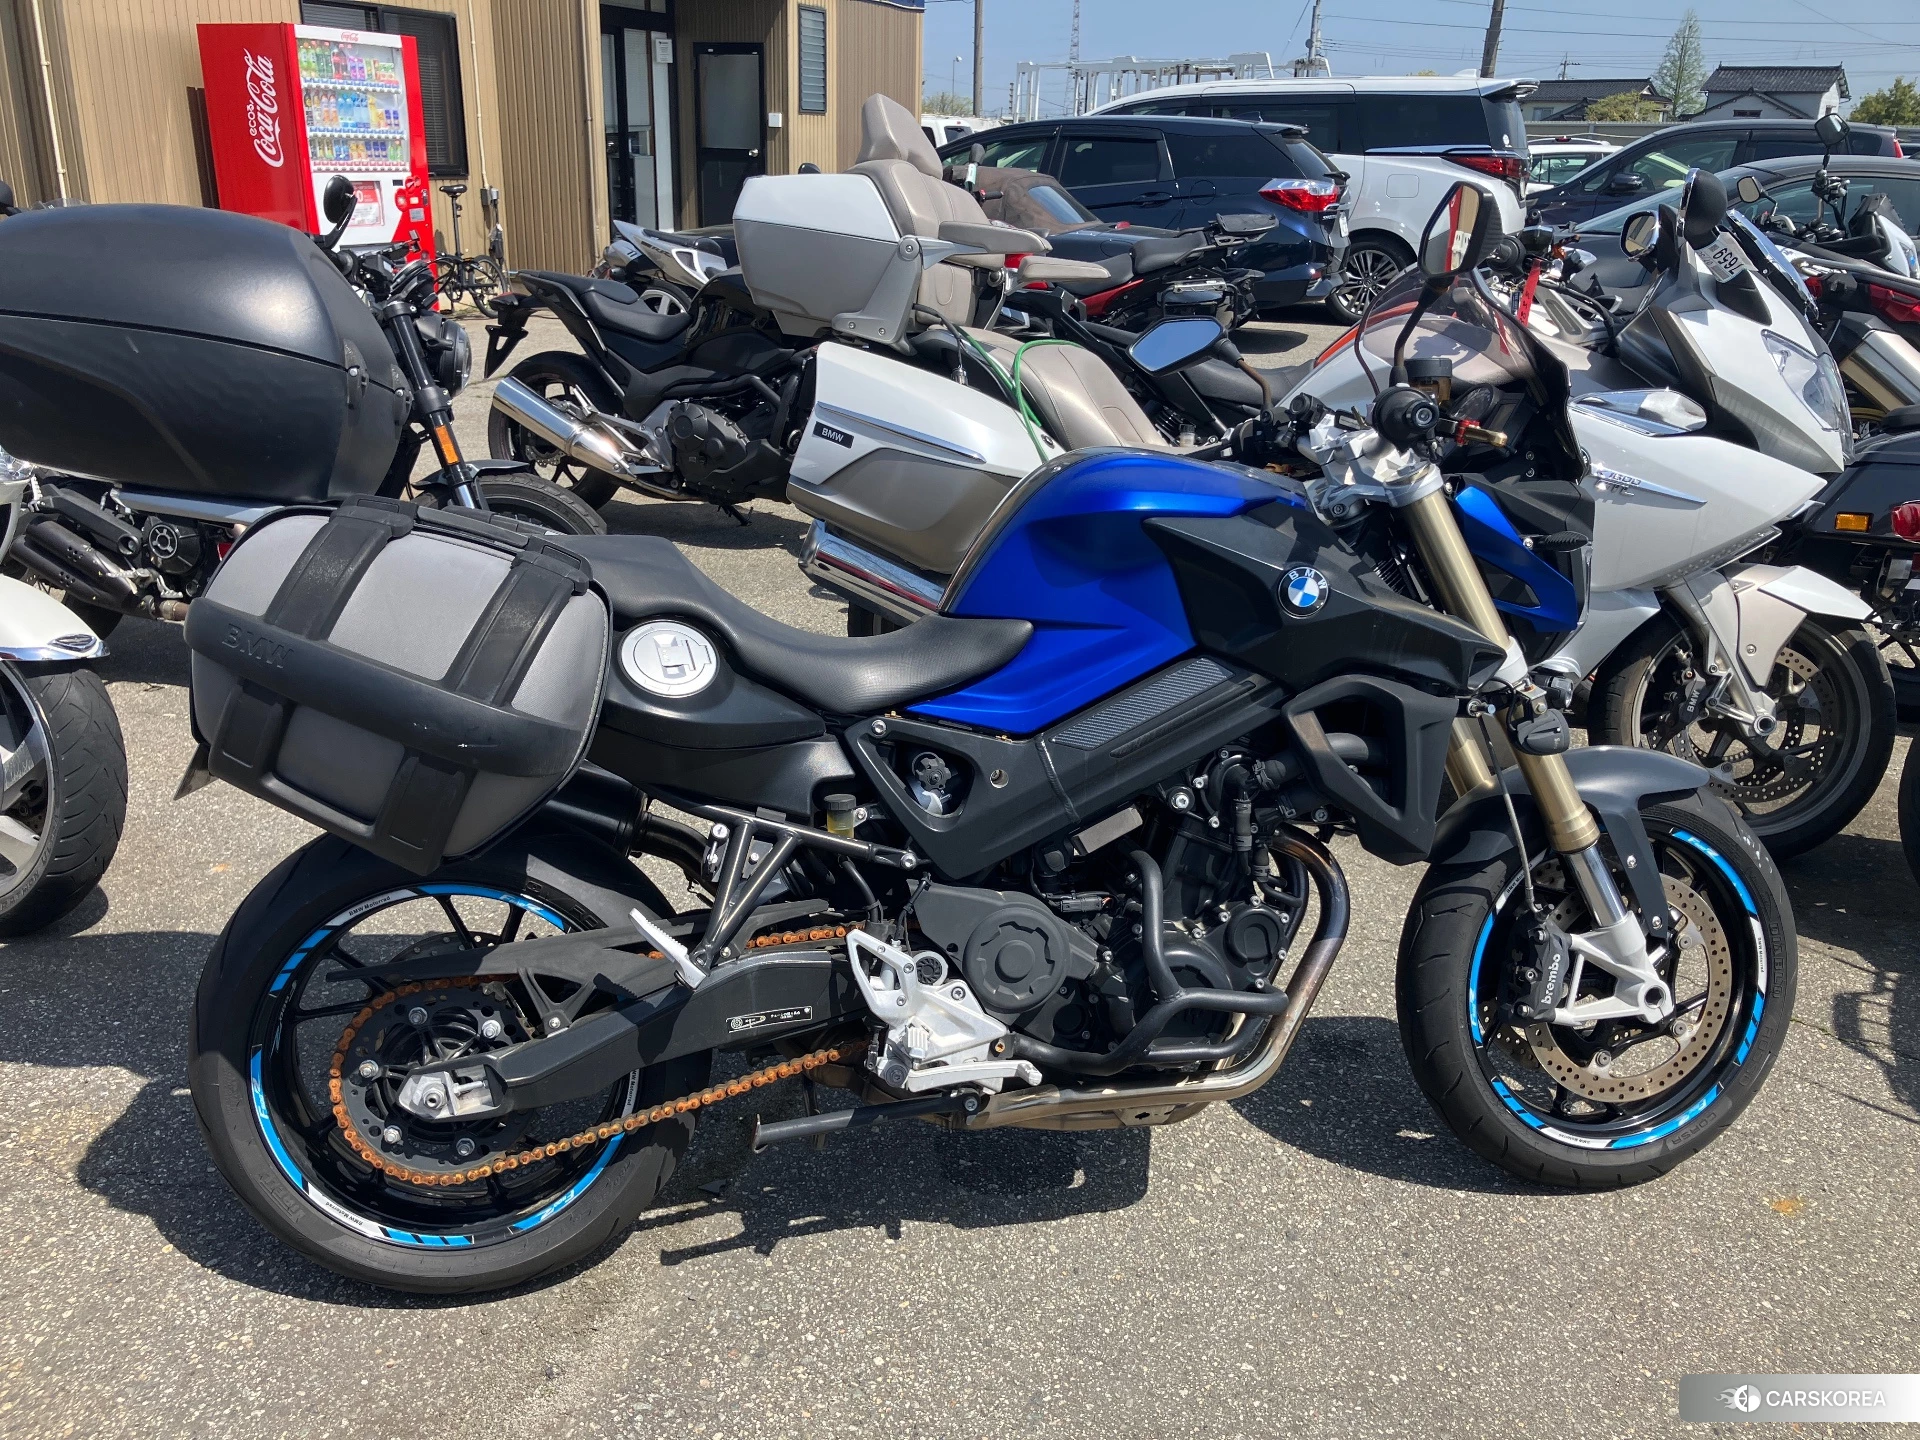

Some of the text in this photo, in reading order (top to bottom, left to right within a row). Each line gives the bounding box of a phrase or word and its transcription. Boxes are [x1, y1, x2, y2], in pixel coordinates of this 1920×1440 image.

[243, 48, 284, 168] Coca-Cola
[1712, 247, 1744, 275] 7659
[822, 428, 844, 442] BMW
[1289, 568, 1328, 590] BMW
[221, 623, 295, 669] BMW
[1686, 689, 1701, 713] BMW
[348, 896, 391, 916] BMW Motorrad
[1541, 953, 1561, 1005] brembo
[1671, 1112, 1717, 1145] CORSA
[325, 1201, 350, 1219] Motorrad
